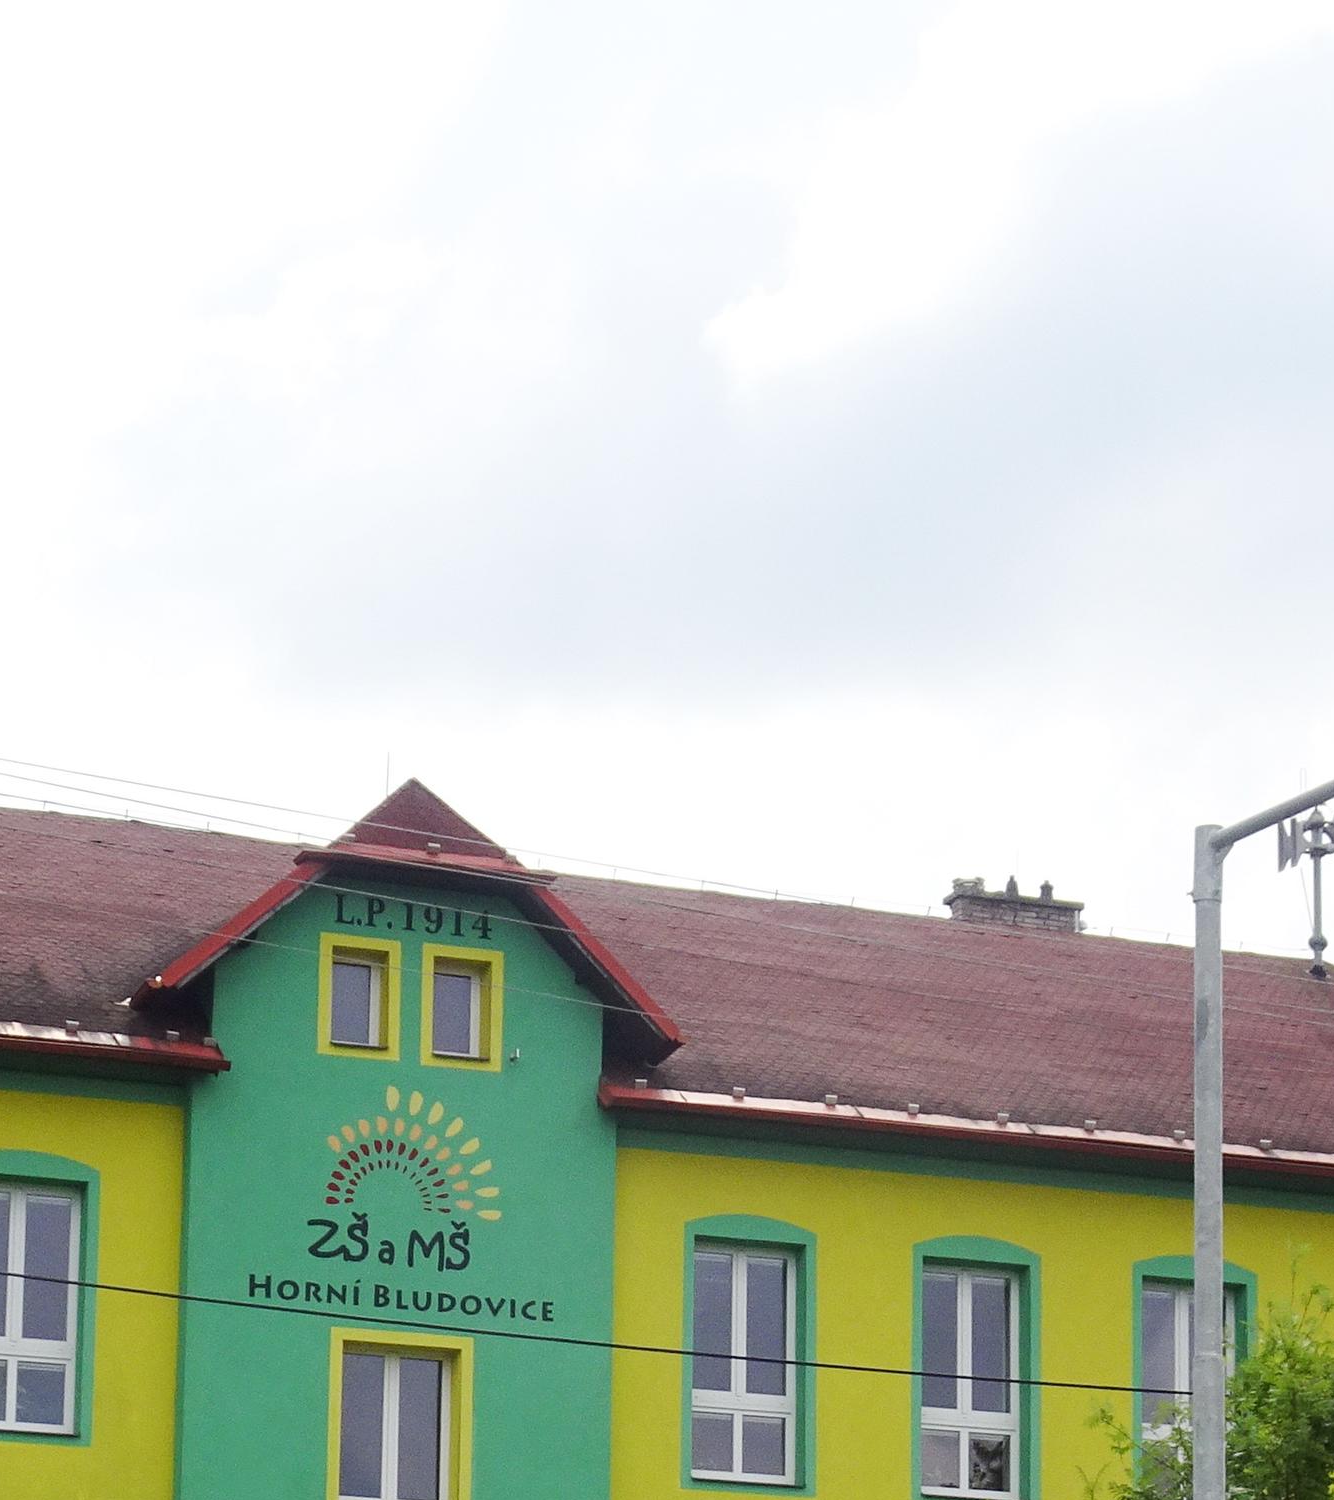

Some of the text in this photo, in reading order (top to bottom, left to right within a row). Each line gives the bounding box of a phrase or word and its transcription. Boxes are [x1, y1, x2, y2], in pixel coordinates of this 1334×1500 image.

[306, 1212, 471, 1272] ZŠ a MŠ
[249, 1273, 554, 1323] HORNÍ BLUDOVICE
